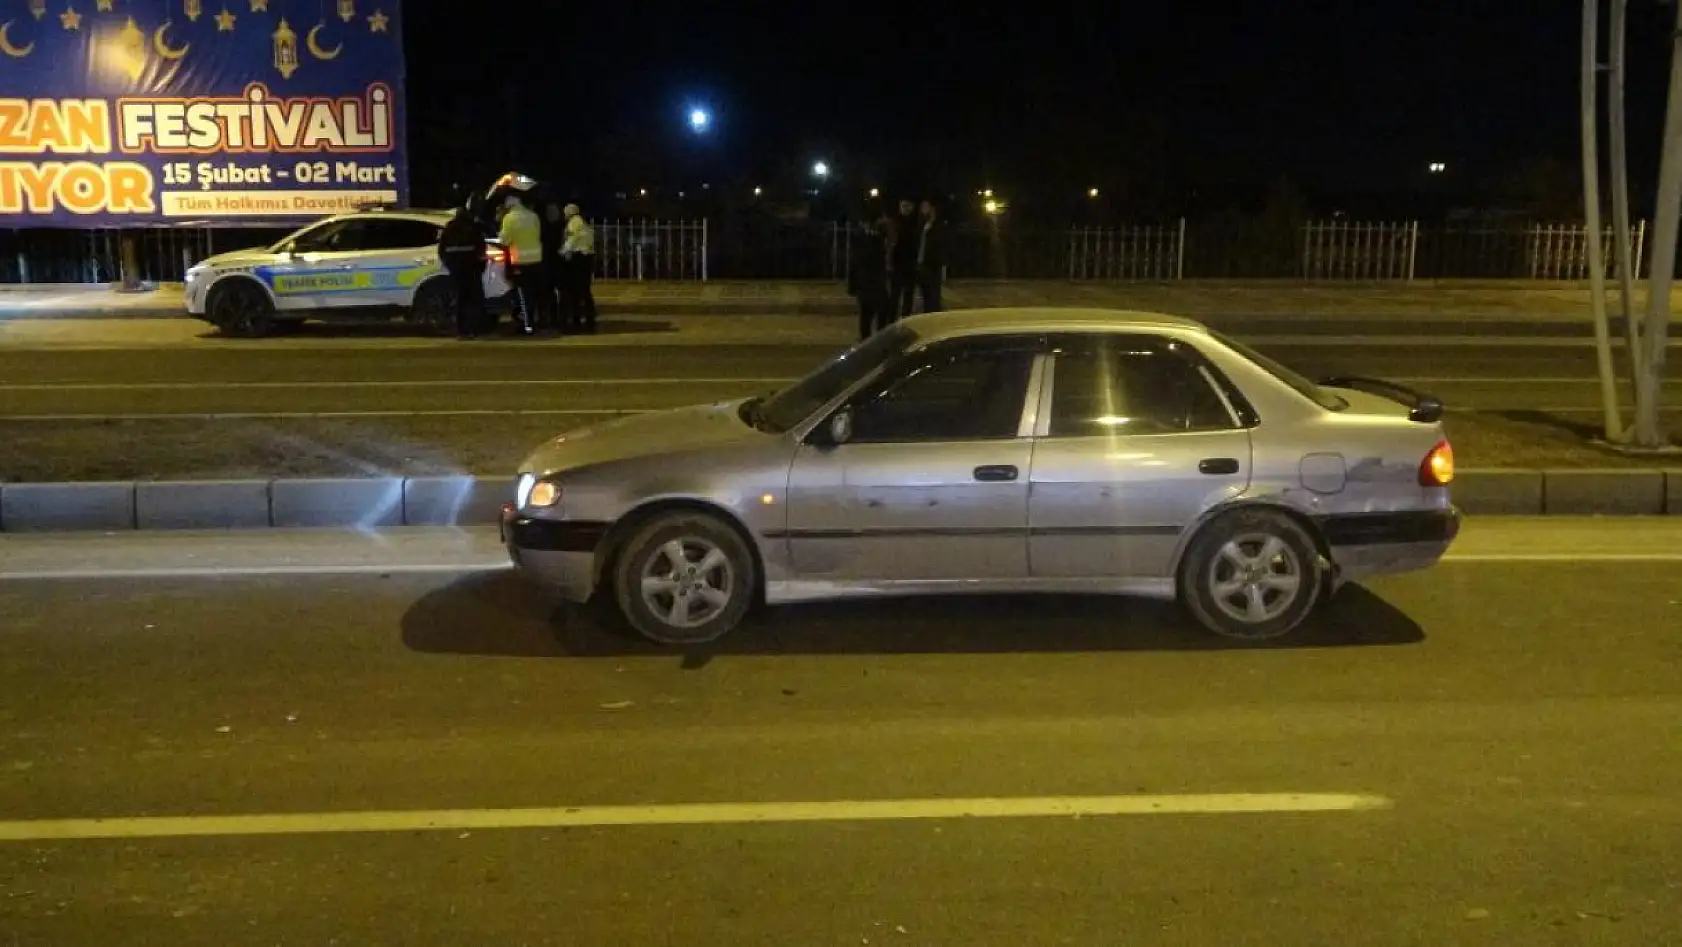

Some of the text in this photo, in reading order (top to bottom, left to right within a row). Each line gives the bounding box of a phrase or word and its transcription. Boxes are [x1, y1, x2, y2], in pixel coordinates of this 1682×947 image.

[121, 85, 391, 149] FESTİVALİ
[162, 163, 191, 183] 15
[197, 162, 271, 190] Şubat
[295, 163, 329, 183] 02
[336, 162, 396, 183] Mart
[177, 196, 212, 210] Tüm
[218, 196, 288, 210] Halkımız
